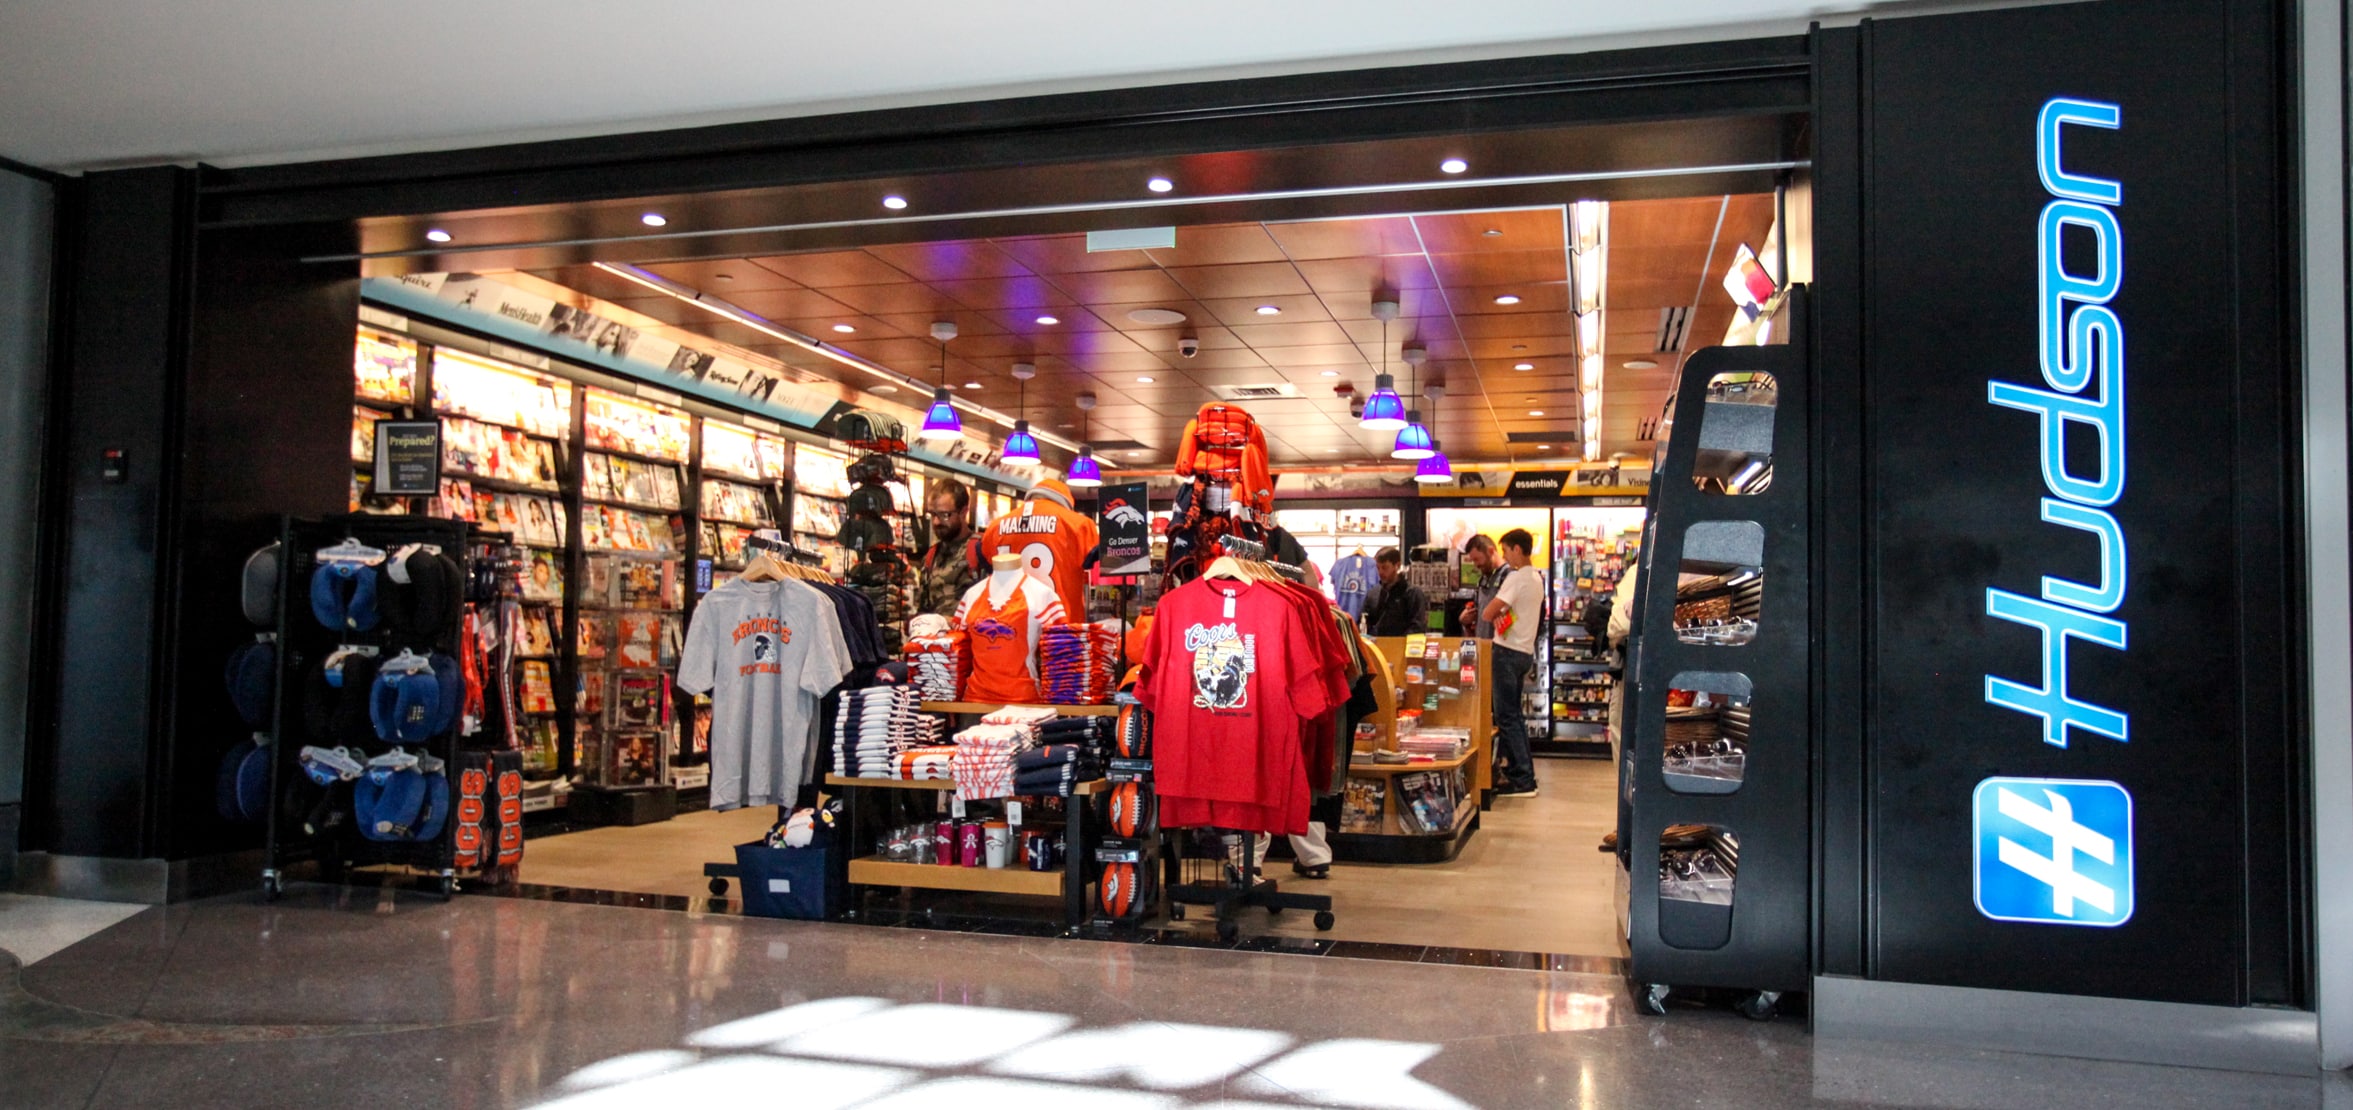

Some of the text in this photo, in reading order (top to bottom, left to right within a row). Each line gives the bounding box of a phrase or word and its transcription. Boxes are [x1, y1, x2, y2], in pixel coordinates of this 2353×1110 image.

[1985, 97, 2129, 748] Hudson
[389, 435, 436, 448] Prepared?
[1515, 478, 1558, 489] essentials
[1108, 536, 1138, 546] Go Denver
[1106, 546, 1141, 557] Broncos
[732, 617, 793, 646] BRONCS
[1185, 623, 1238, 651] Coors
